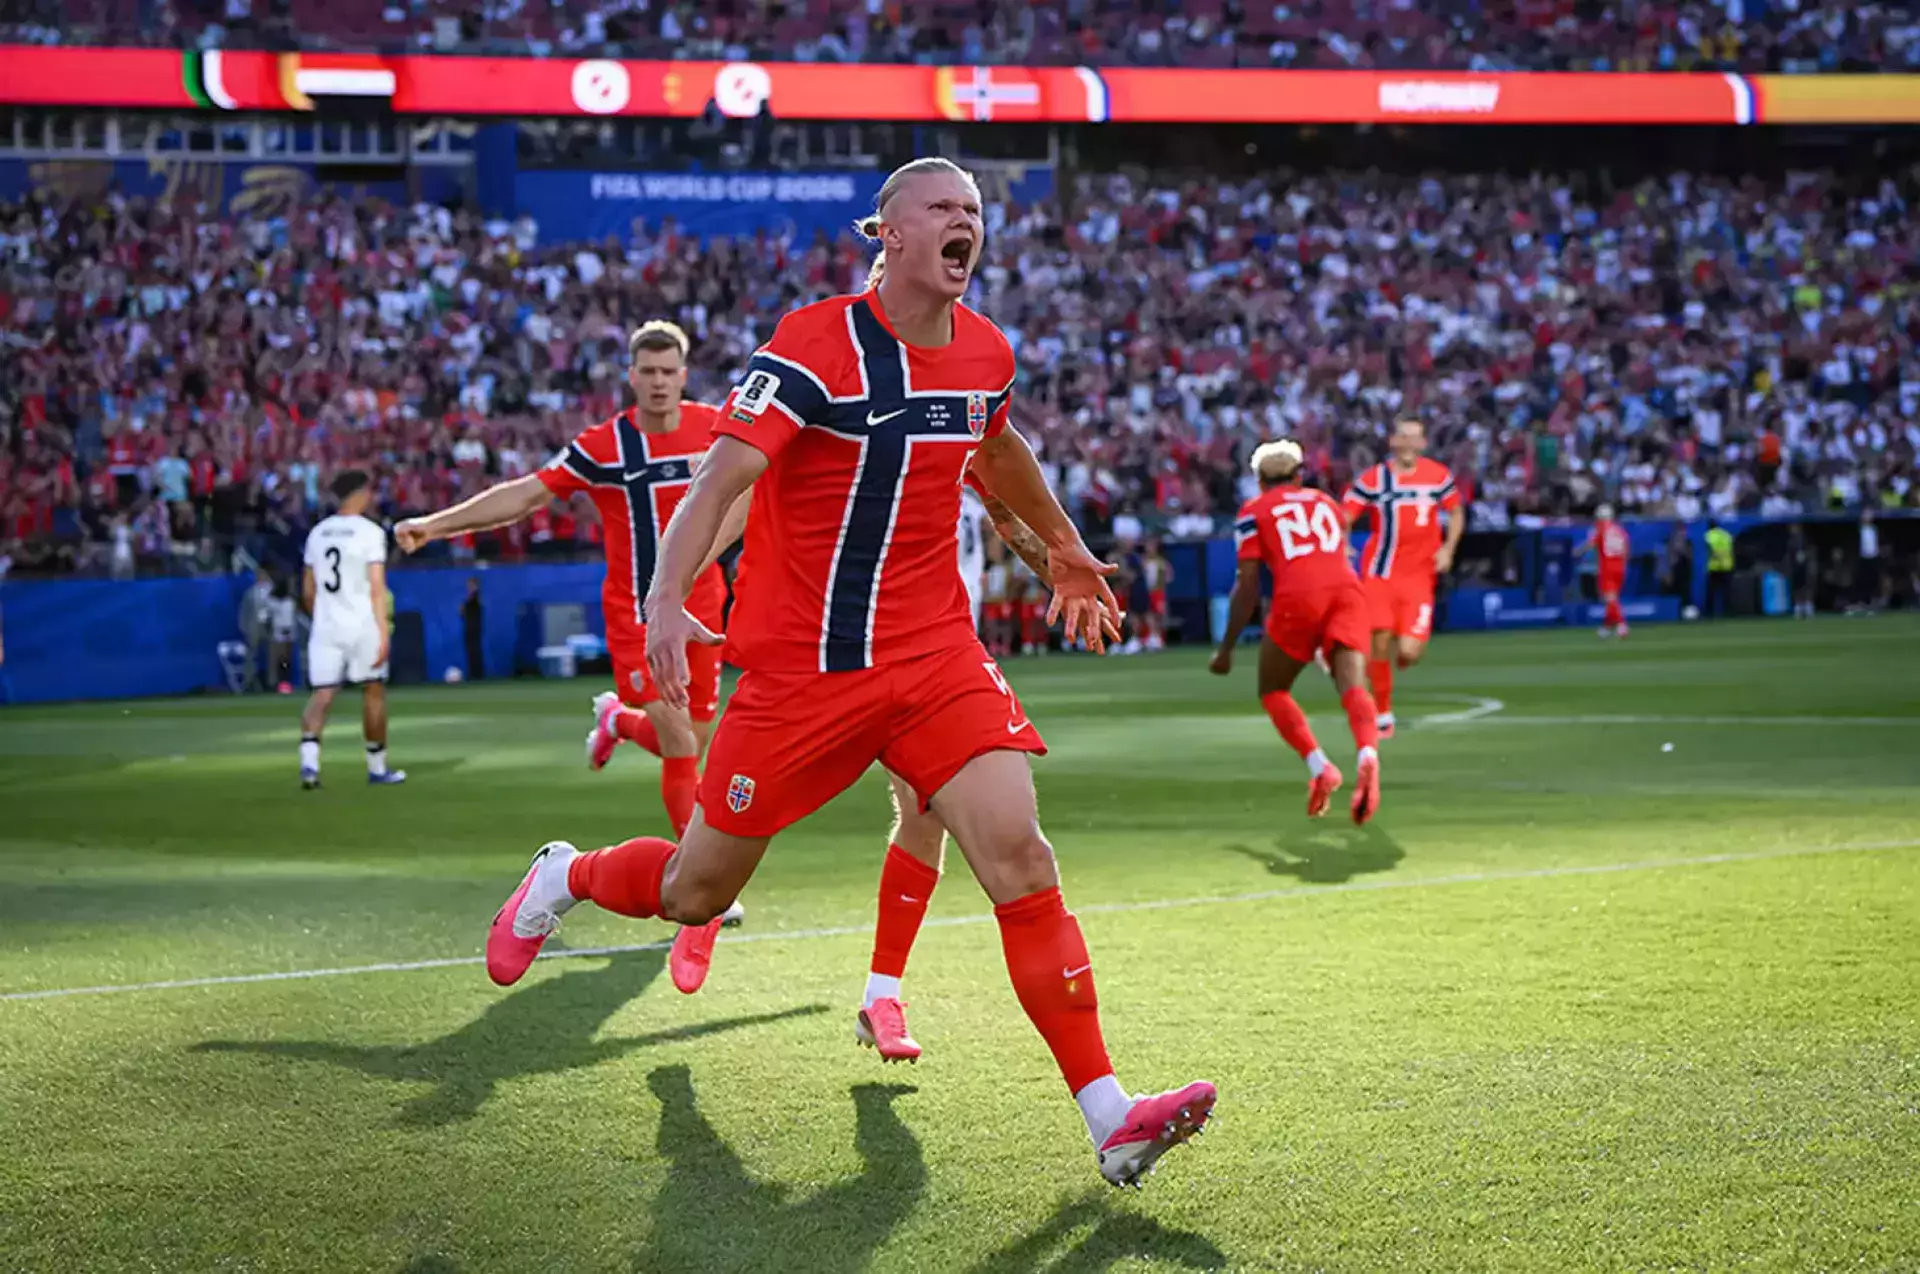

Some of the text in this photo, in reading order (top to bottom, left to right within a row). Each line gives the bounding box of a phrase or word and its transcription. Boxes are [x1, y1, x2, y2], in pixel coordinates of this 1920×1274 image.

[591, 174, 641, 199] FIFA
[642, 175, 725, 200] WORLD
[726, 176, 773, 201] CUP
[1271, 502, 1341, 560] 20
[325, 547, 341, 593] 3
